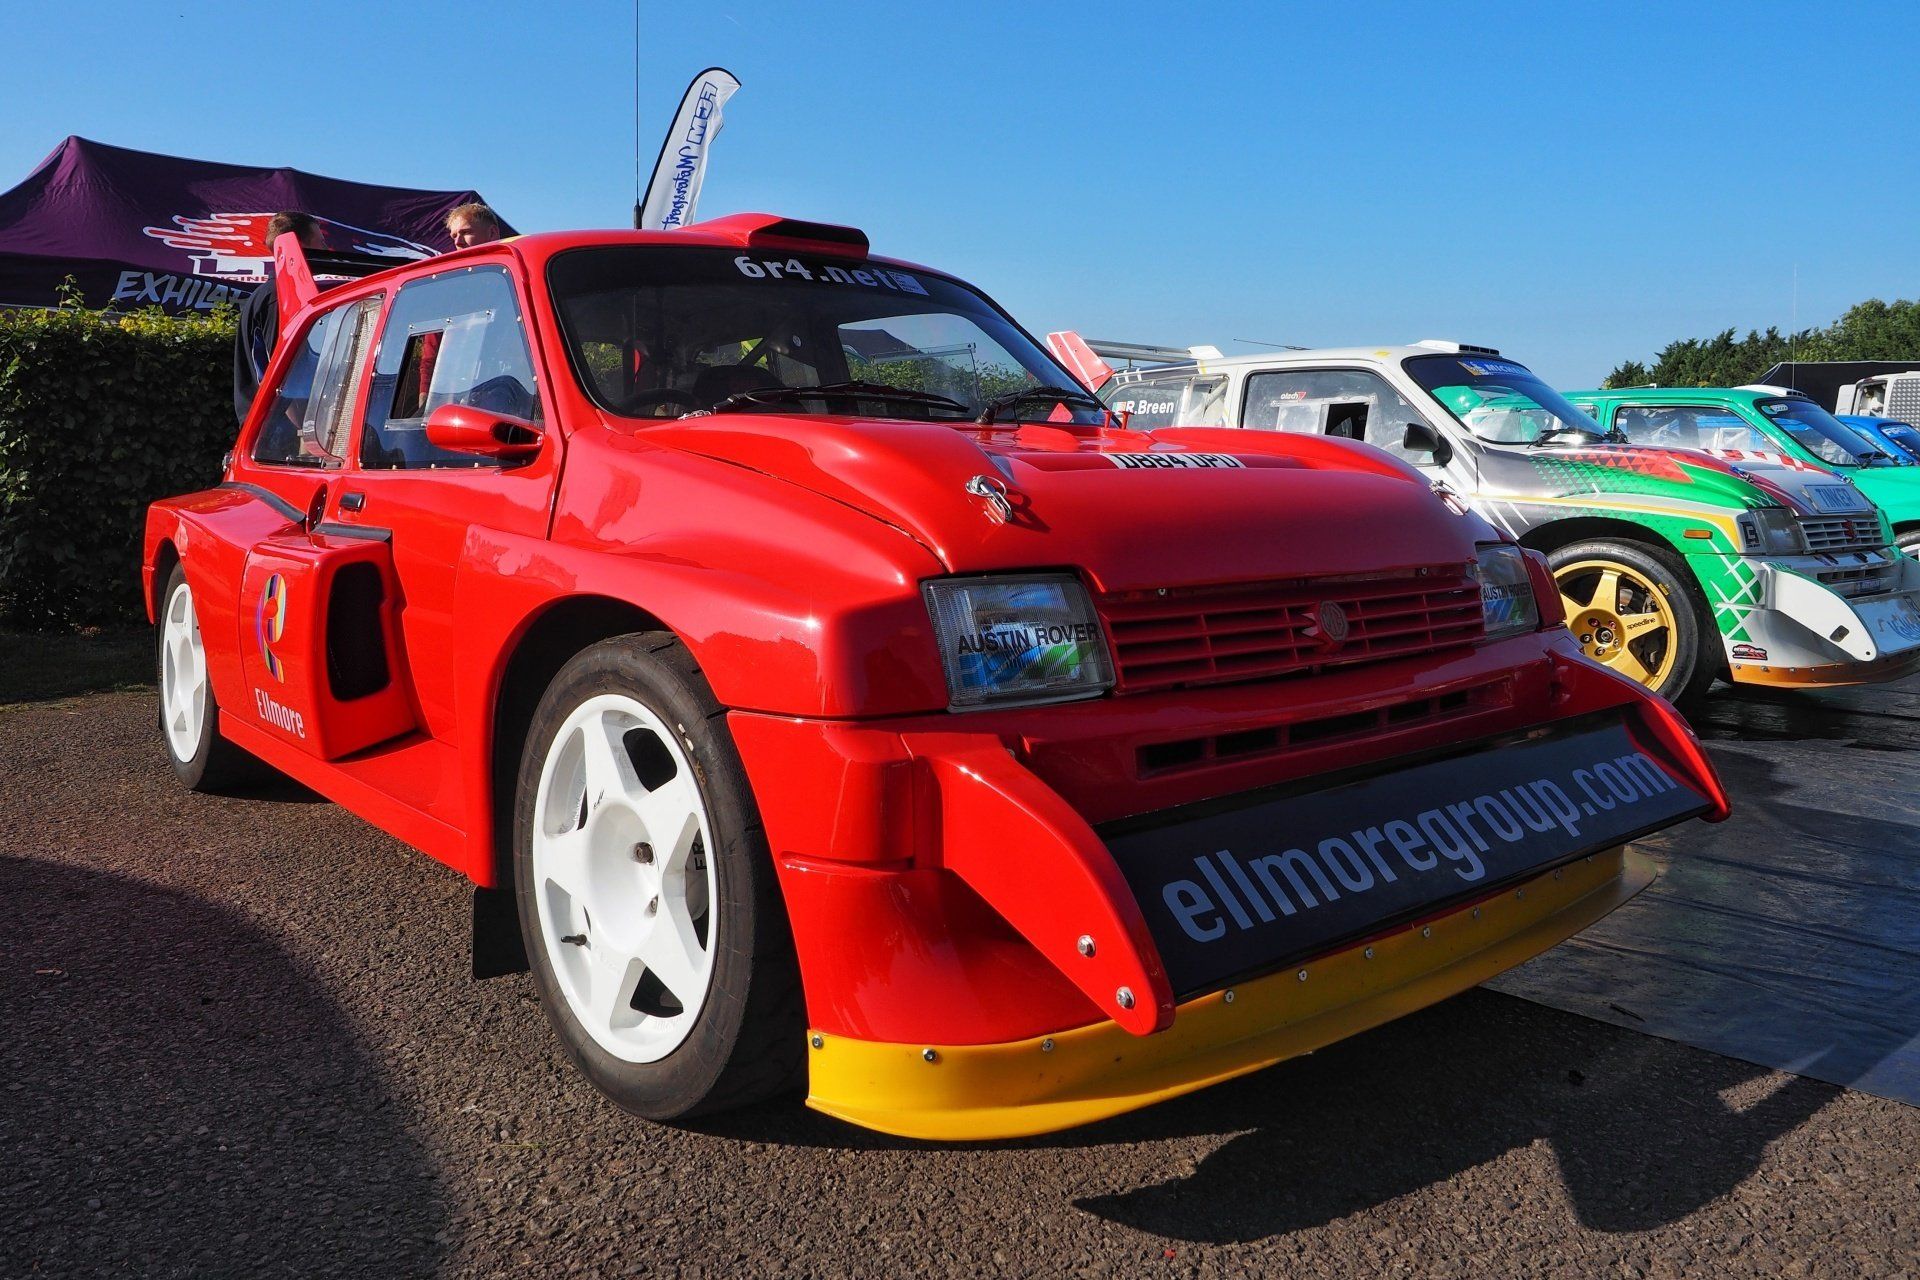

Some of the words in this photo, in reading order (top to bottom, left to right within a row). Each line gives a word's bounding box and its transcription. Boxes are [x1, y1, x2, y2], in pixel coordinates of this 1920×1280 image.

[734, 256, 898, 290] 6r4.net
[1126, 399, 1175, 415] R.Breen
[1815, 488, 1857, 508] TINKER
[957, 628, 1031, 655] AUSTIN
[1036, 621, 1102, 647] ROVER
[1626, 617, 1656, 631] speedline
[254, 687, 307, 740] Ellmore
[1161, 749, 1678, 943] ellmoregroup.com
